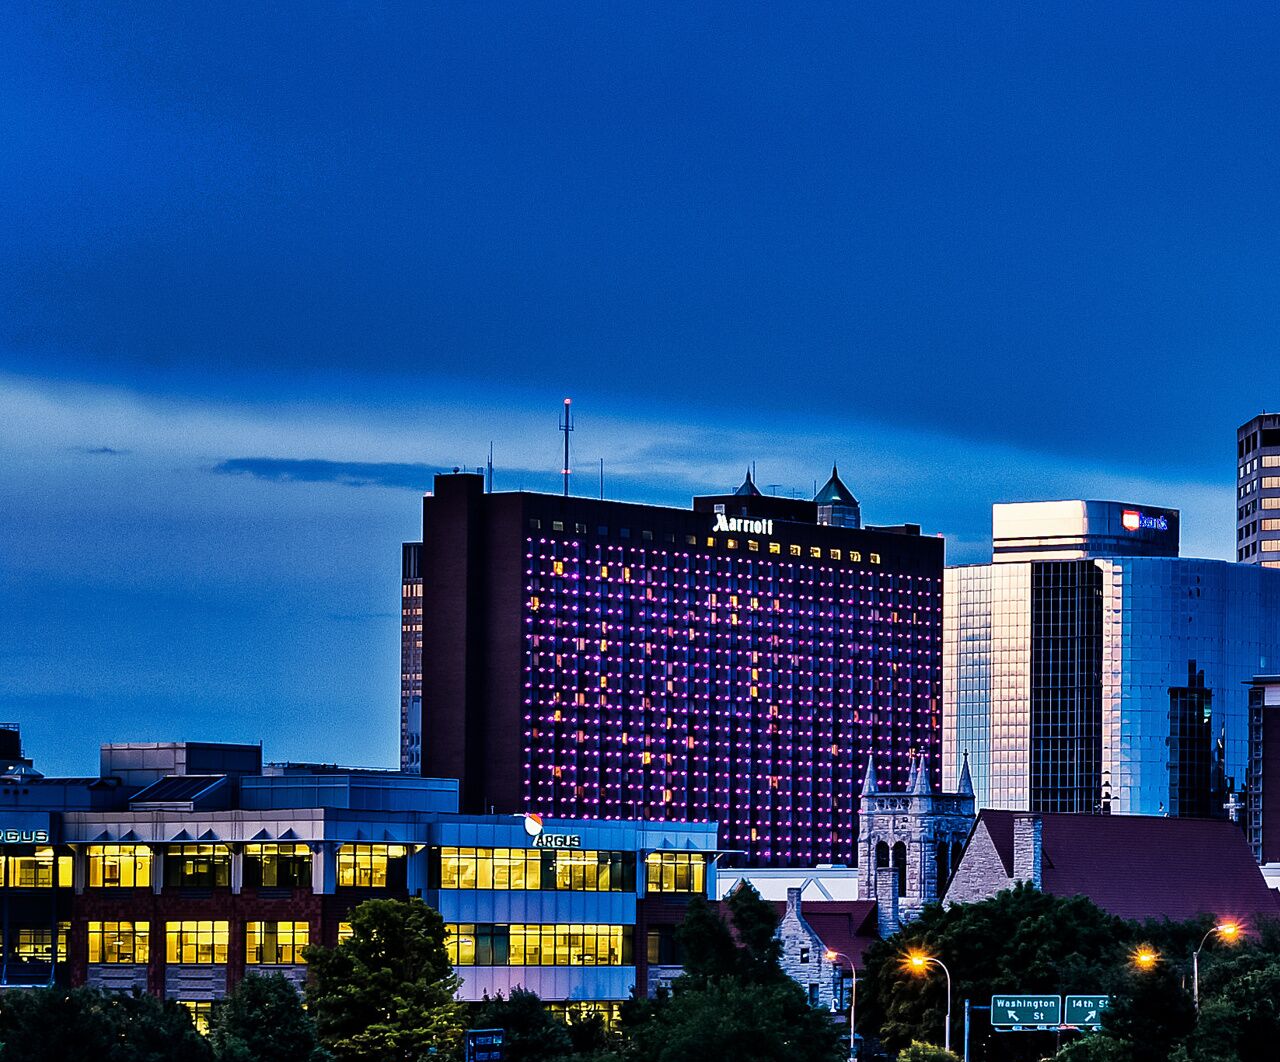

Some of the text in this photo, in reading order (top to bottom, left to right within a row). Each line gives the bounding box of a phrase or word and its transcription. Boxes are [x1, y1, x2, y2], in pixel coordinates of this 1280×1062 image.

[712, 513, 773, 535] Marriott
[0, 829, 48, 843] GUS
[535, 834, 581, 847] ARGUS
[997, 999, 1055, 1010] Washington
[1072, 1000, 1094, 1008] 14th
[1033, 1012, 1044, 1020] St
